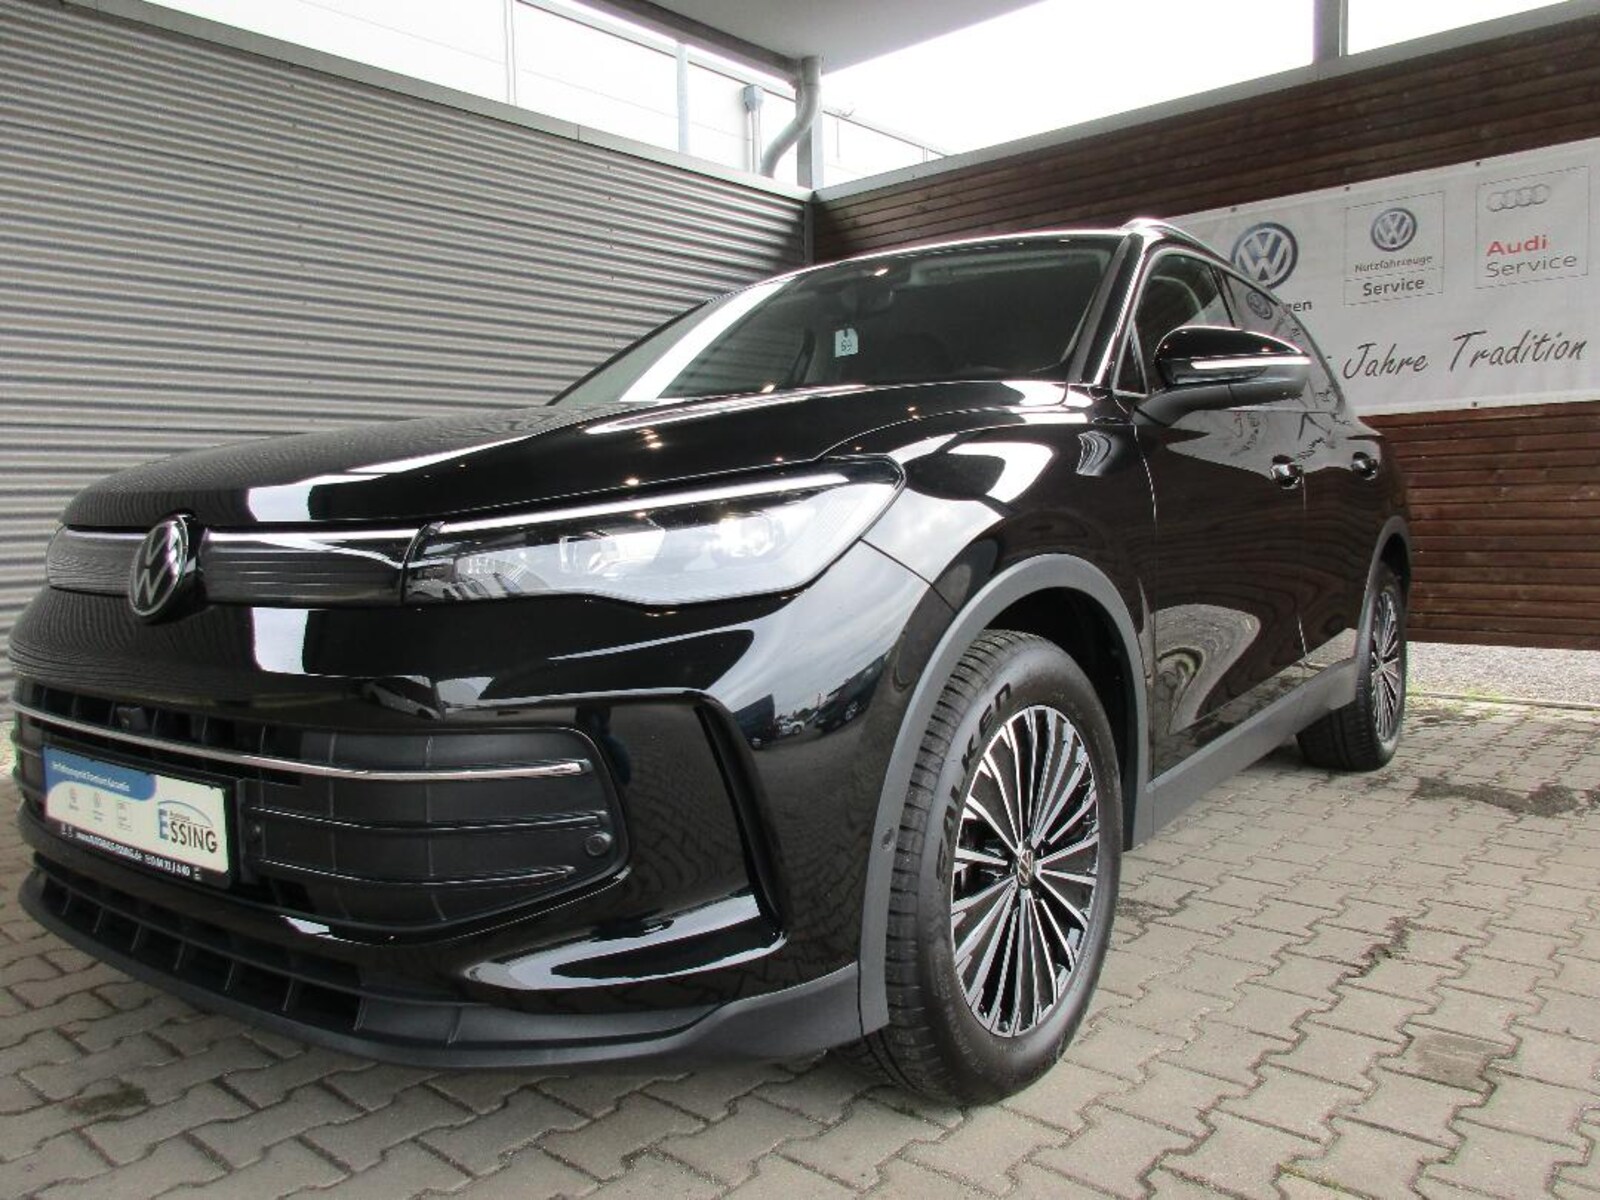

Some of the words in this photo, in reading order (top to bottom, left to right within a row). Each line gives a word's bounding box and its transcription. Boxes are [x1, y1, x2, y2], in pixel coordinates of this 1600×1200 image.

[1486, 235, 1547, 256] Audi
[1355, 256, 1433, 273] Nutzfahrzeuge
[1485, 256, 1578, 278] Service
[1363, 278, 1425, 296] Service
[1343, 343, 1429, 380] Jahre
[1450, 329, 1588, 373] Tradition
[158, 808, 218, 853] ESSING
